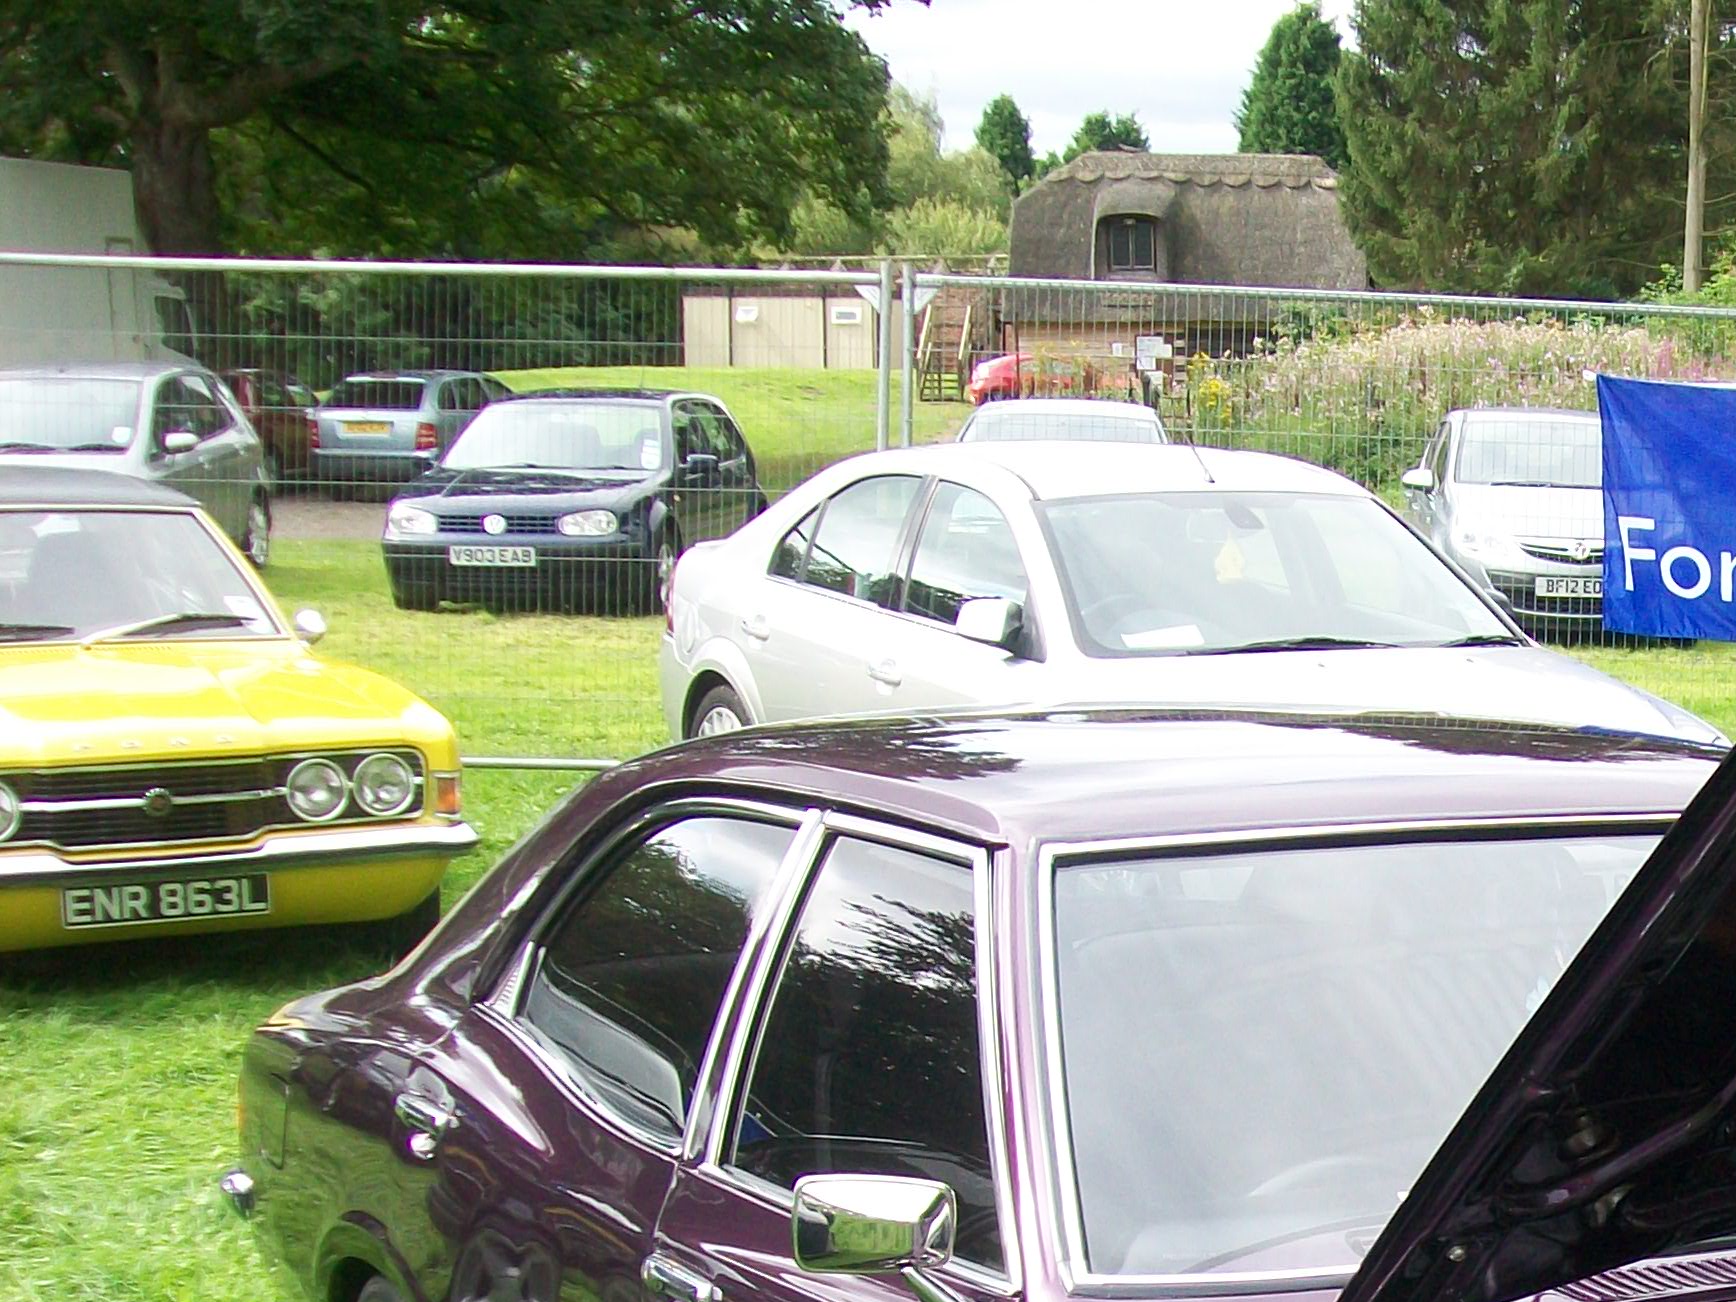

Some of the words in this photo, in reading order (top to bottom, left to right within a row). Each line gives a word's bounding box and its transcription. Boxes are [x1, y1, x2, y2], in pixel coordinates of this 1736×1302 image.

[452, 547, 496, 562] V903
[1546, 579, 1579, 593] BF12
[1583, 579, 1603, 594] EO
[64, 885, 149, 924] ENR
[159, 877, 267, 917] 863L
